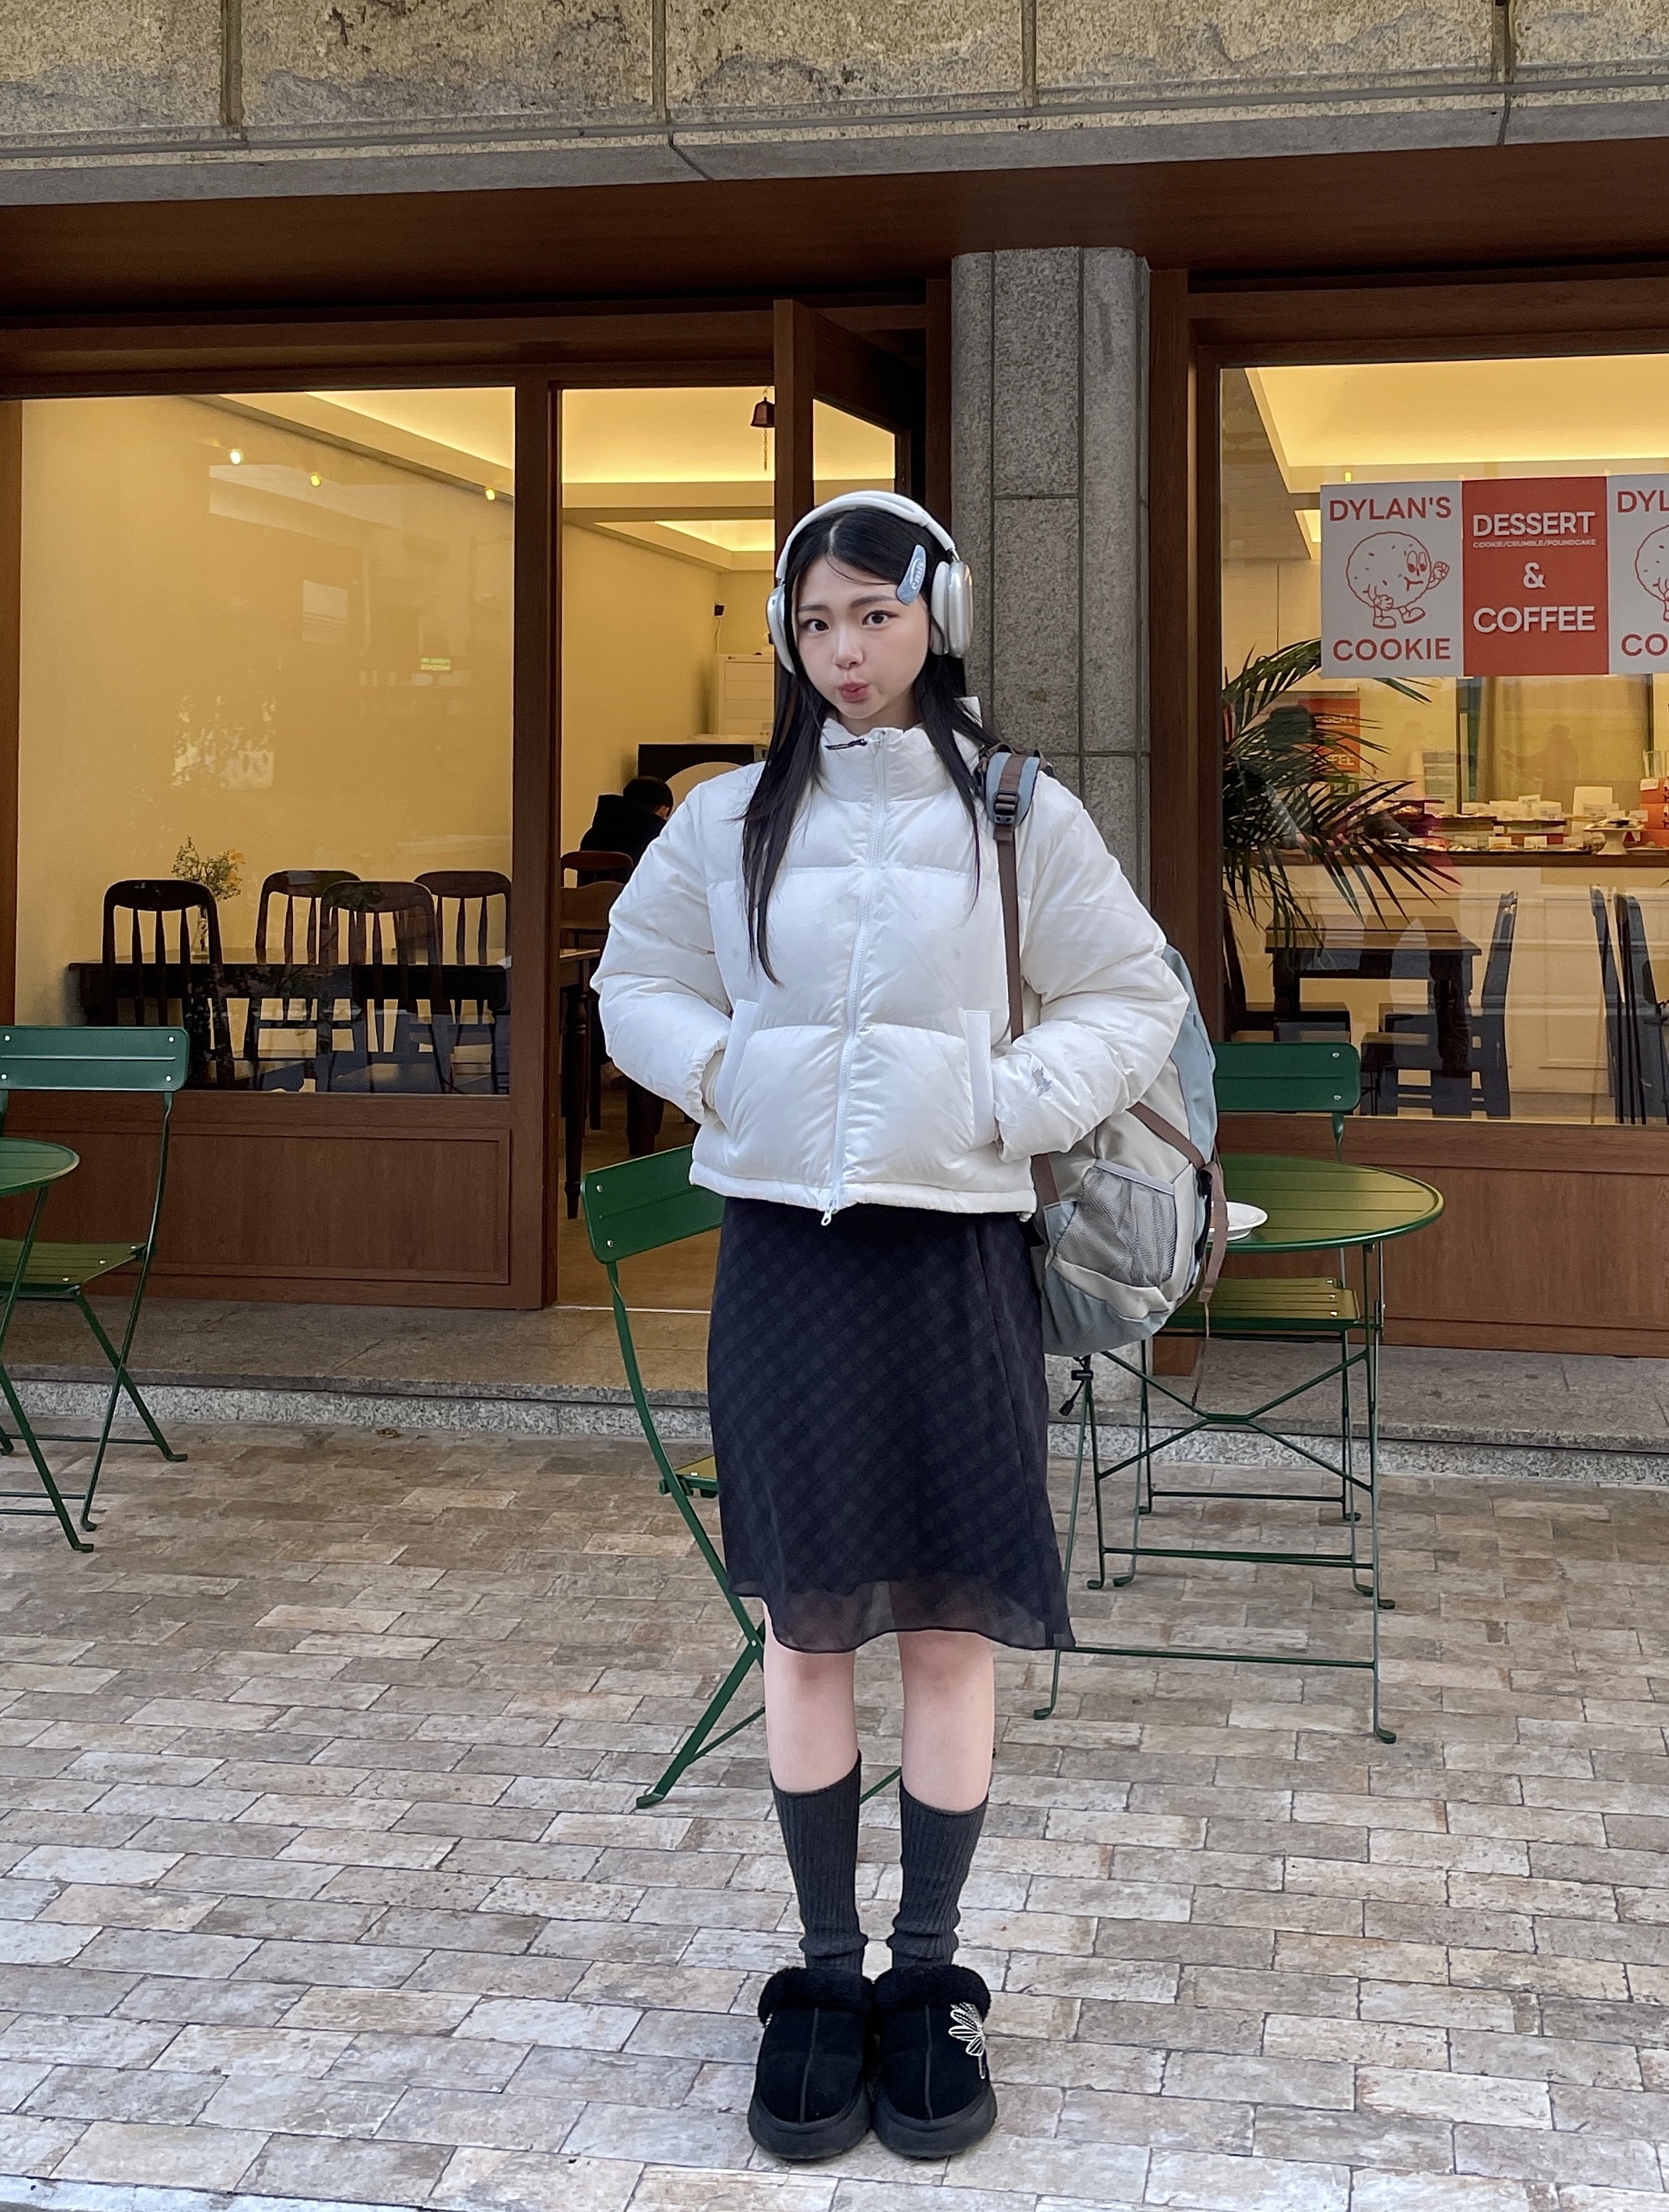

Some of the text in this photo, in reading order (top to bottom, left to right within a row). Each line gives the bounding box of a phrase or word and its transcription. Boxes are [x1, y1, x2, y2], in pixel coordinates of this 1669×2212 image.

[1329, 496, 1451, 522] DYLAN'S
[1473, 511, 1596, 537] DESSERT
[1523, 562, 1546, 589] &
[1473, 605, 1596, 633] COFFEE
[1332, 638, 1451, 661] COOKIE
